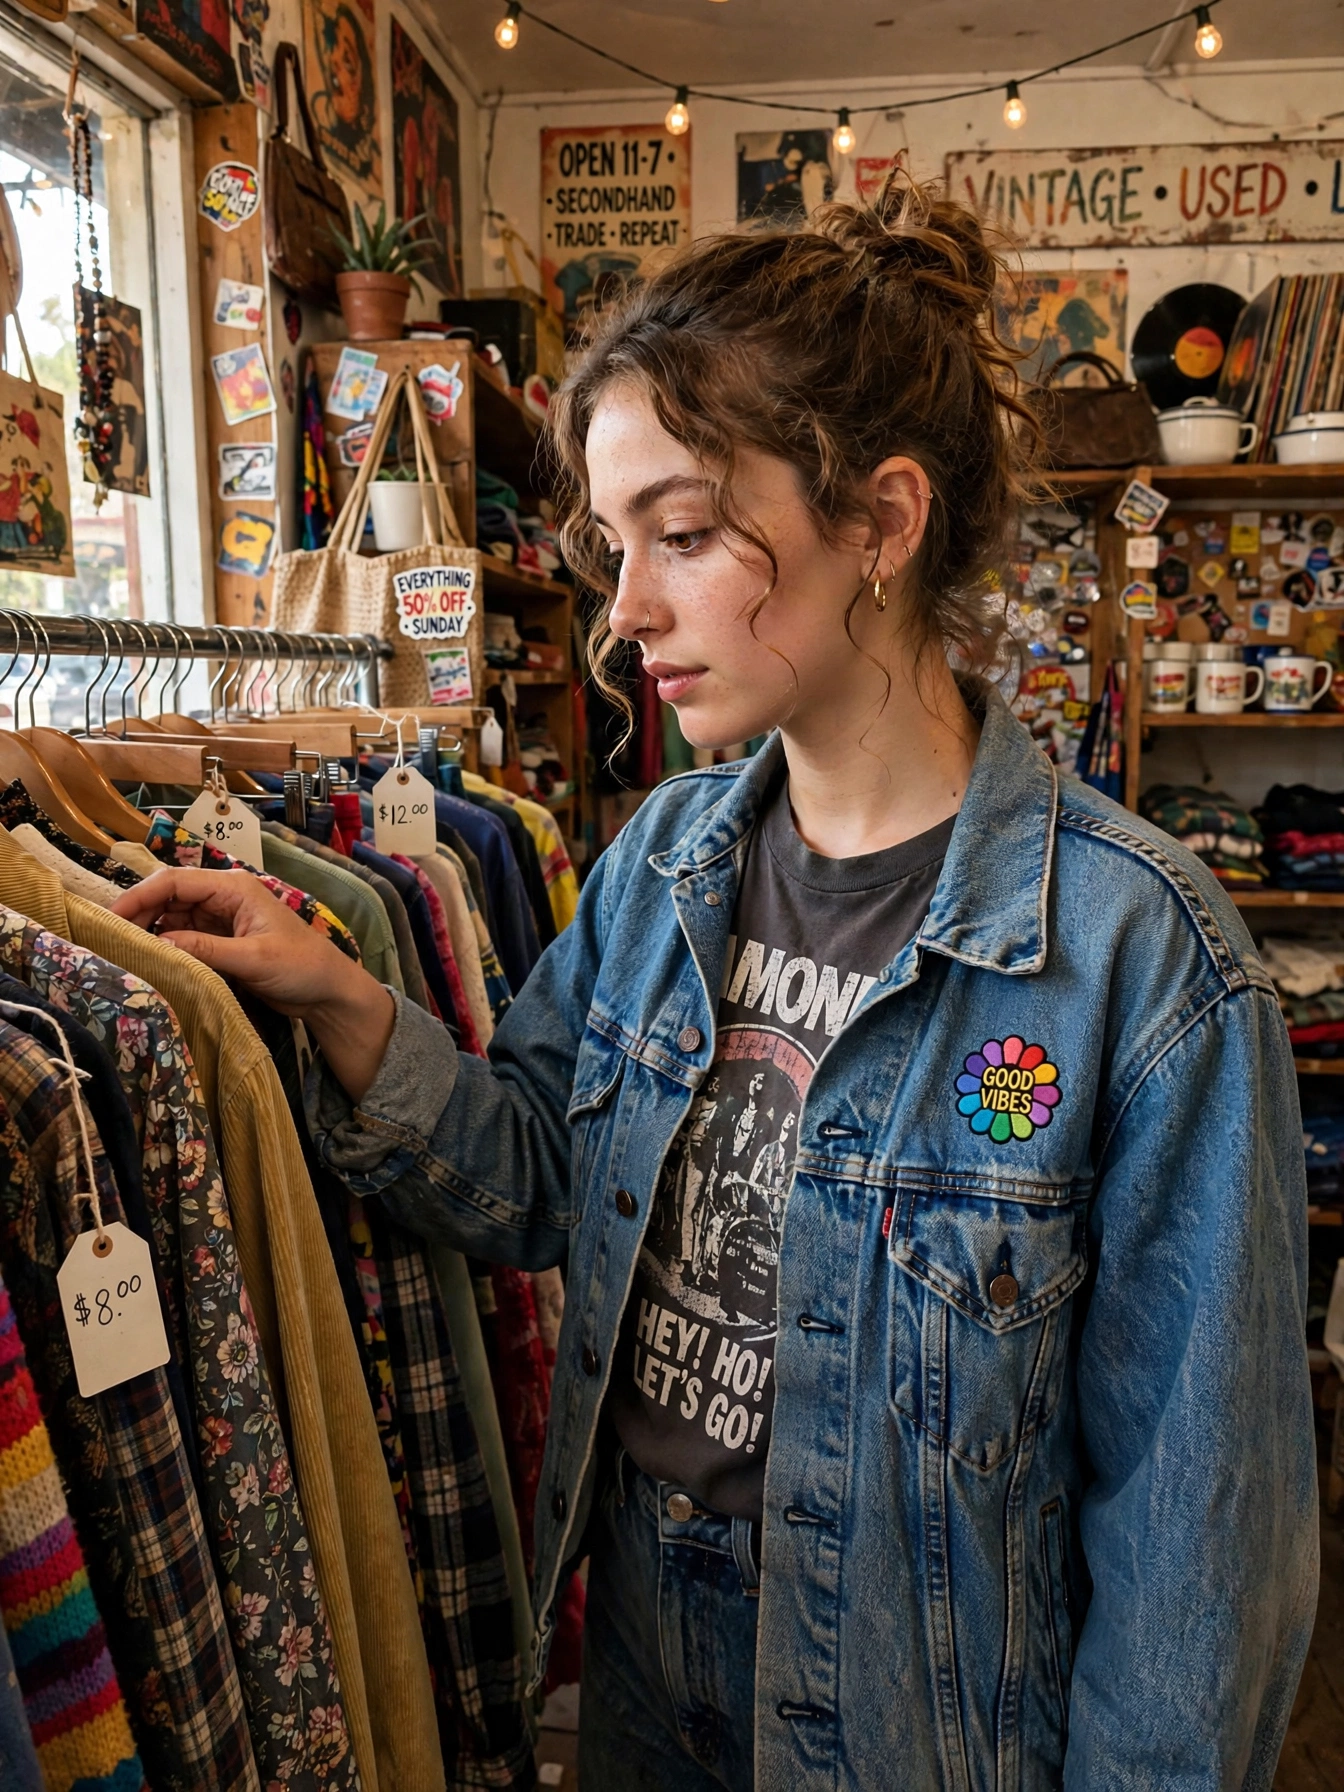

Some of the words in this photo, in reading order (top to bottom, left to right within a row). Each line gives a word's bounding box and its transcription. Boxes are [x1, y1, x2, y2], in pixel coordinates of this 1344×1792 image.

[559, 140, 615, 177] OPEN
[556, 185, 676, 214] SECONDHAND
[964, 165, 1144, 228] VINTAGE
[1179, 162, 1288, 222] USED
[555, 221, 606, 247] TRADE
[620, 219, 679, 246] REPEAT
[397, 570, 471, 593] EVERYTHING
[403, 592, 437, 616] 50%
[440, 591, 467, 613] OFF
[412, 616, 464, 635] SUNDAY
[378, 803, 429, 826] $12.00
[203, 821, 244, 841] $8.00
[982, 1066, 1034, 1091] GOOD
[981, 1087, 1032, 1114] VIBES
[74, 1275, 142, 1328] $8.00
[636, 1297, 711, 1370] HEY!
[710, 1336, 772, 1402] HO!
[633, 1344, 703, 1420] LET'S
[705, 1392, 764, 1454] GO!
